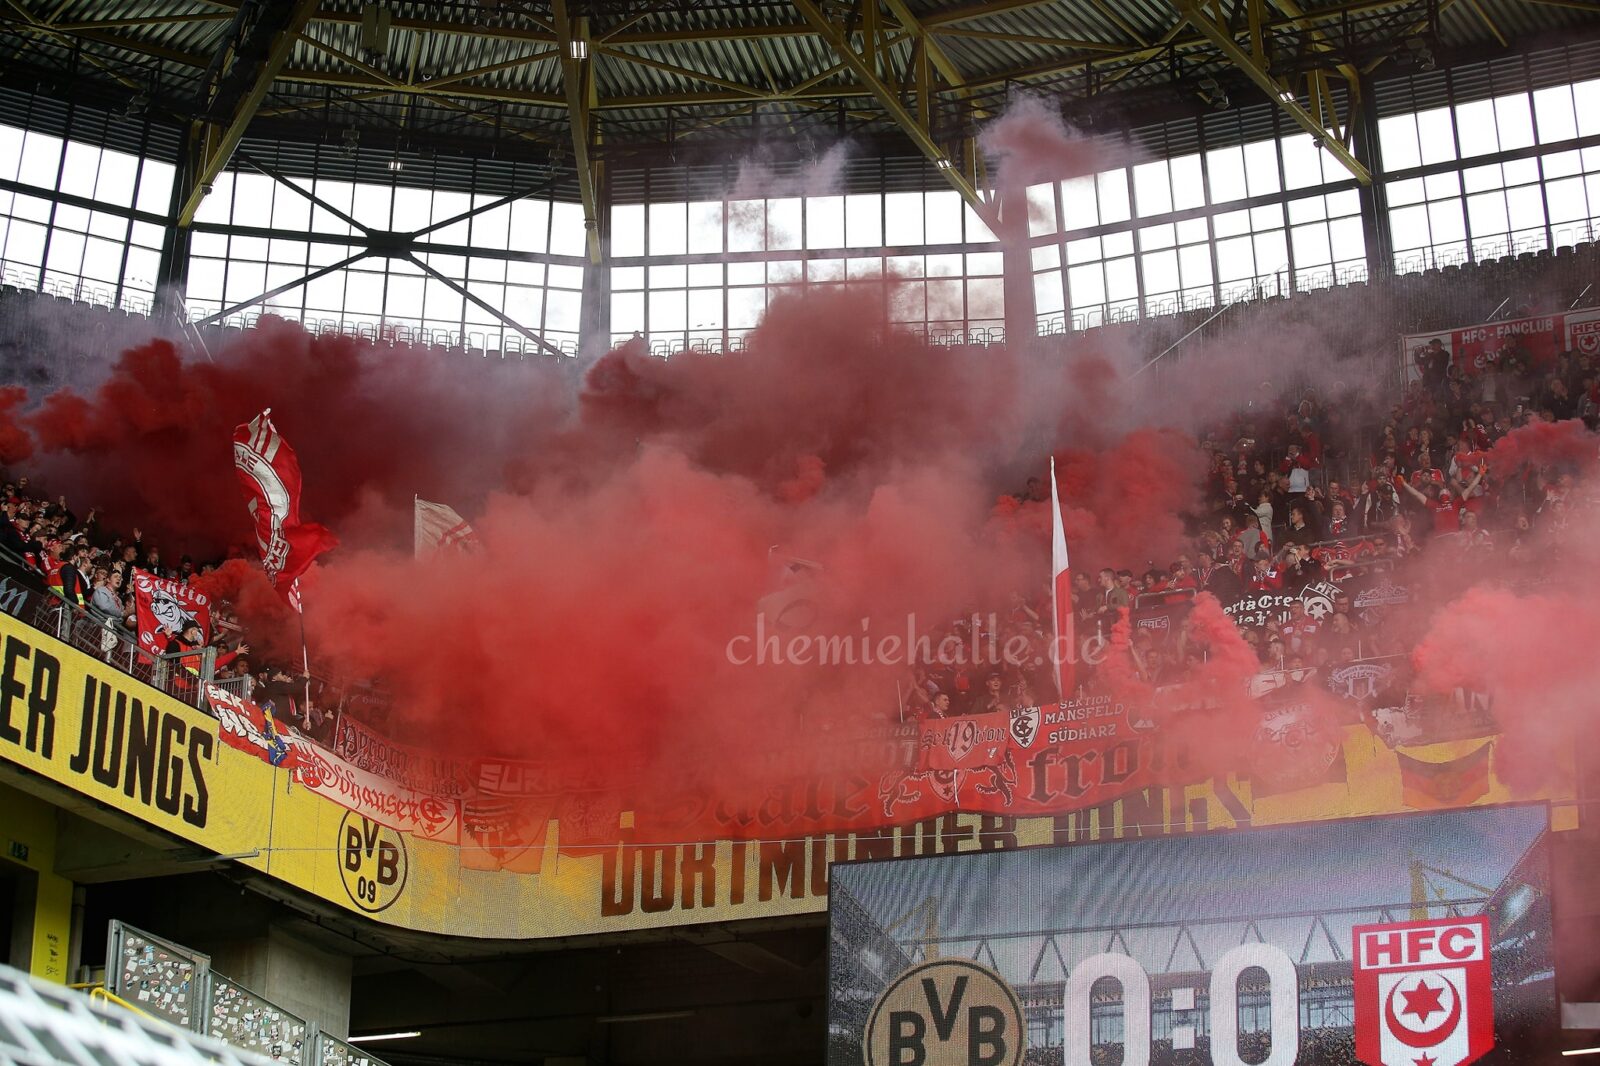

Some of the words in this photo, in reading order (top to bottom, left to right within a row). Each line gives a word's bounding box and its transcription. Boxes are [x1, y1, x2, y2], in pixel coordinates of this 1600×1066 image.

[1462, 329, 1487, 344] HFC
[1497, 317, 1553, 339] FANCLUB
[1573, 322, 1600, 335] HFC
[136, 575, 211, 611] Sektio
[1316, 582, 1340, 600] HFC
[1223, 595, 1256, 616] ertà
[1044, 703, 1124, 724] MANSFELD
[1060, 695, 1112, 709] SEKTION
[0, 634, 61, 760] ER
[70, 674, 214, 830] JUNGS
[1049, 724, 1117, 744] SÜDHARZ
[345, 817, 399, 886] BVB
[358, 876, 376, 903] 09
[1366, 925, 1484, 967] HFC
[889, 975, 1007, 1066] BVB
